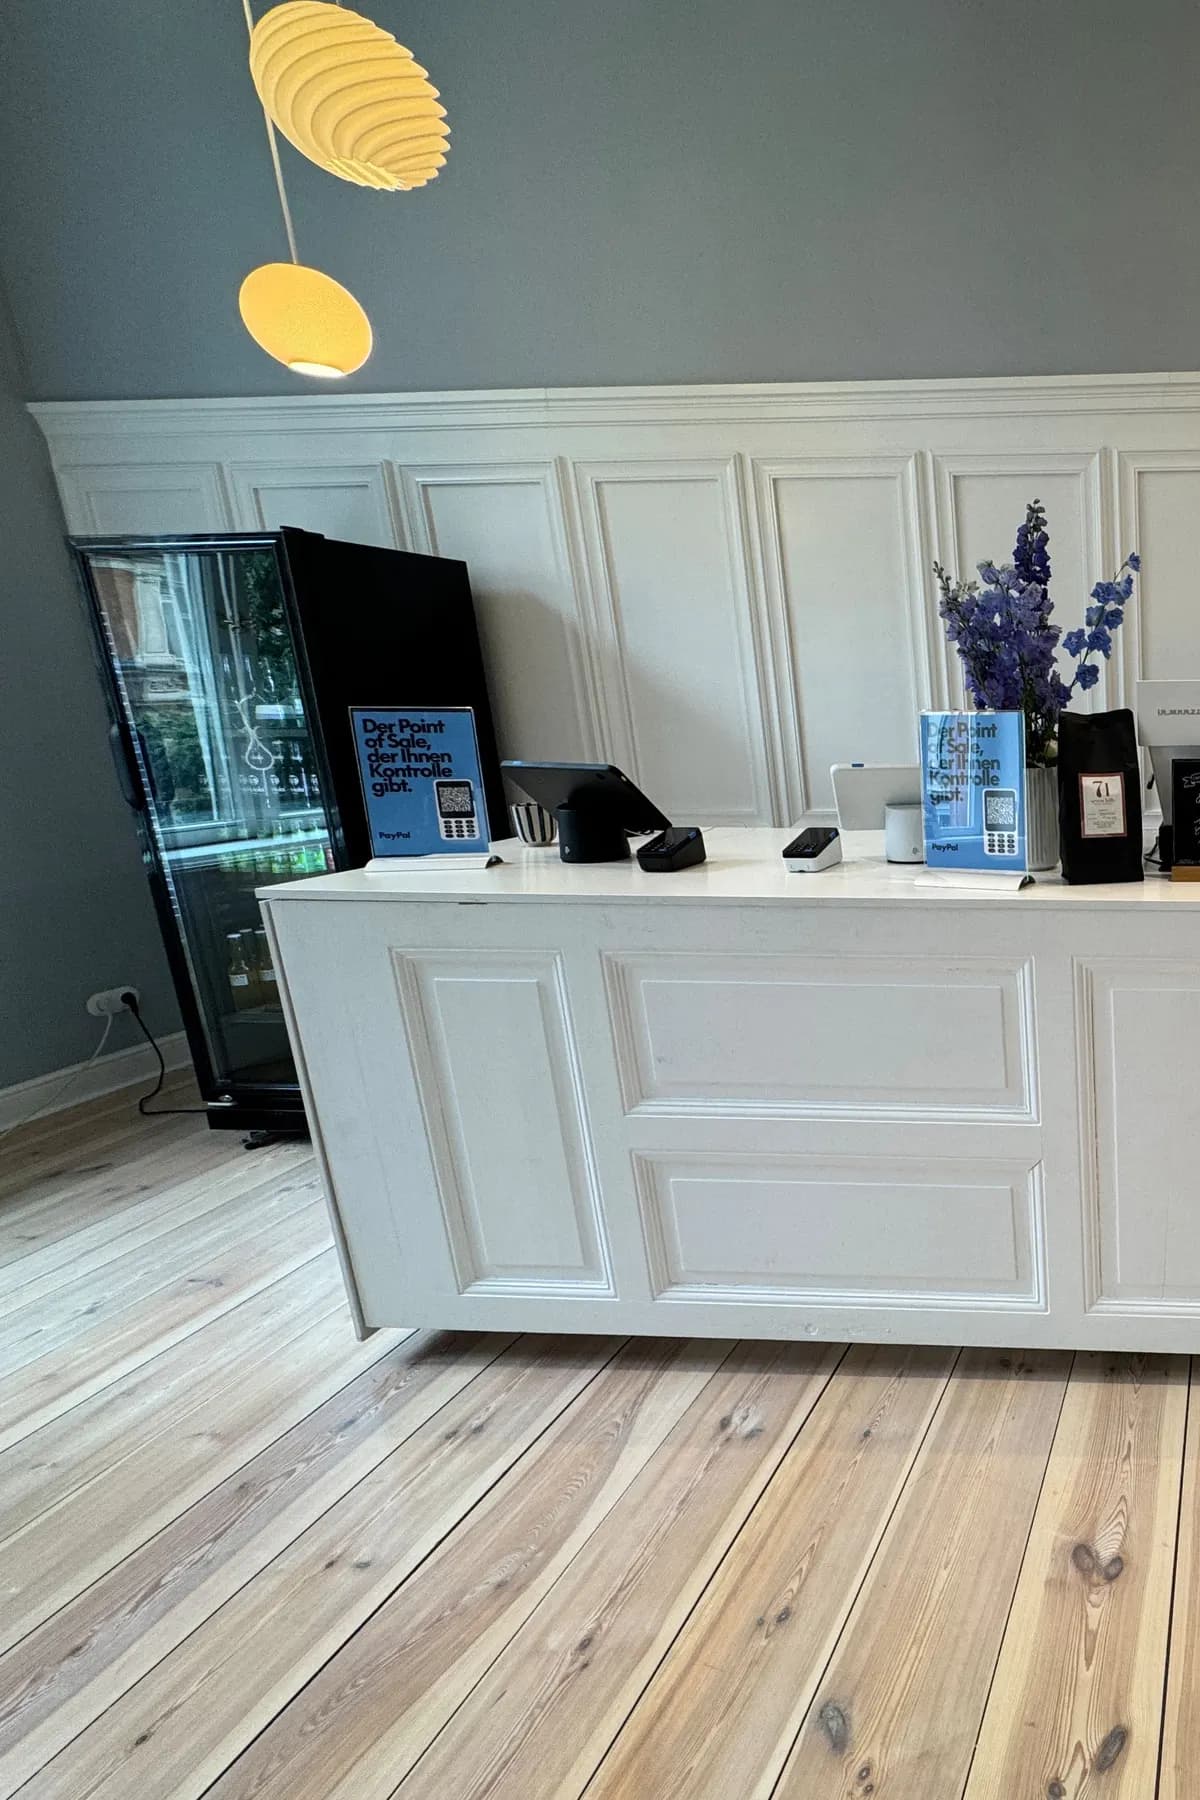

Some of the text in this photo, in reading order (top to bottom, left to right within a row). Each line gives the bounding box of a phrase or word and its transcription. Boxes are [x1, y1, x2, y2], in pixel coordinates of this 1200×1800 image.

[362, 718, 446, 734] Der Point
[928, 722, 998, 738] Der Point
[365, 732, 432, 751] of Sale,
[947, 738, 984, 757] Sale,
[367, 748, 453, 763] der Ihnen
[368, 762, 453, 778] Kontrolle
[929, 768, 1001, 786] Kontrolle
[372, 777, 413, 797] gibt.
[1092, 780, 1110, 798] 71
[379, 831, 411, 840] PayPal
[931, 843, 959, 853] PayPal
